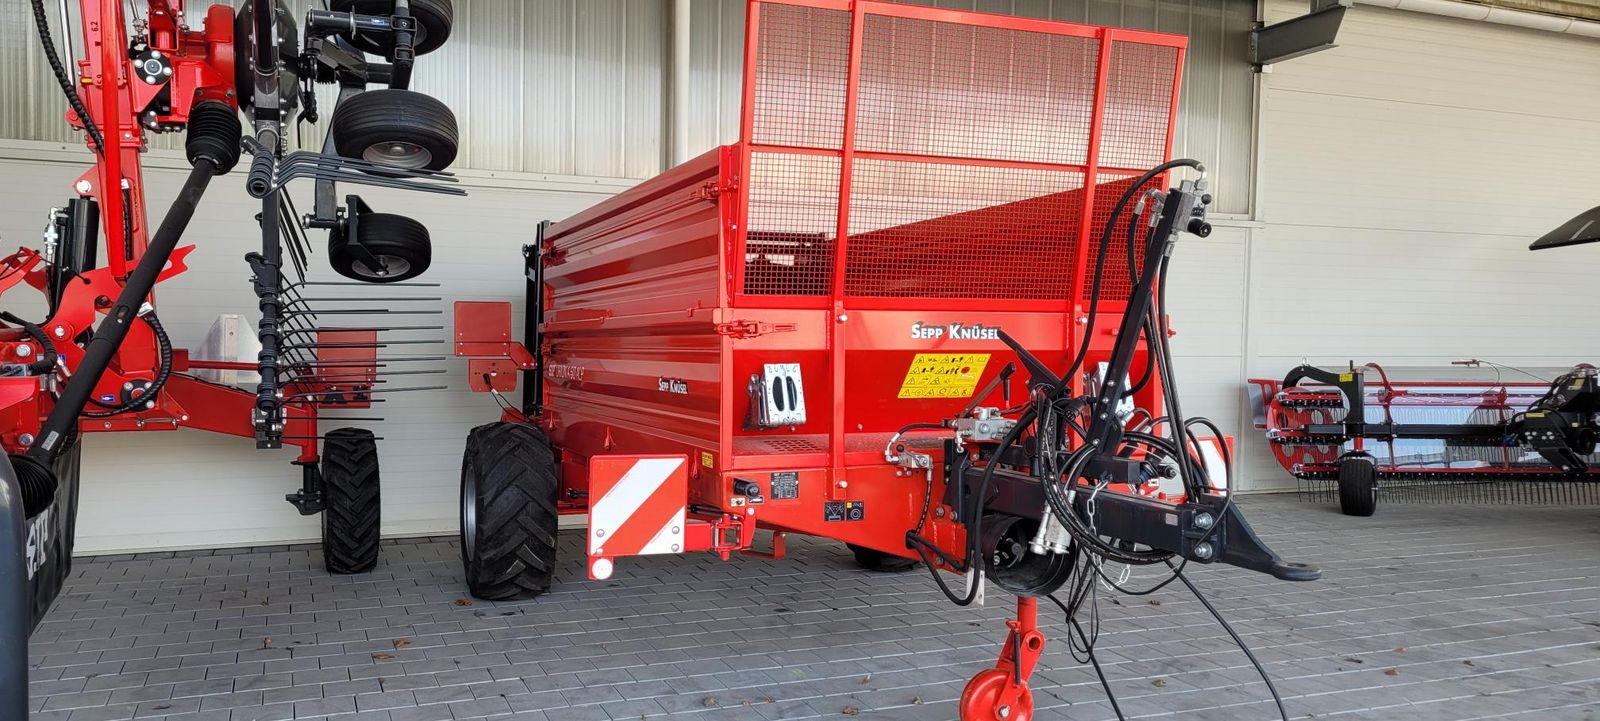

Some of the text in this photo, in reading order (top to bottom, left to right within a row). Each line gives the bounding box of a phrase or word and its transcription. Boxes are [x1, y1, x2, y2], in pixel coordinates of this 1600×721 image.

[90, 21, 99, 32] 6.2
[911, 323, 1000, 340] SEPP KNÜSEL
[658, 377, 669, 391] SEPP
[26, 509, 48, 581] SIP
